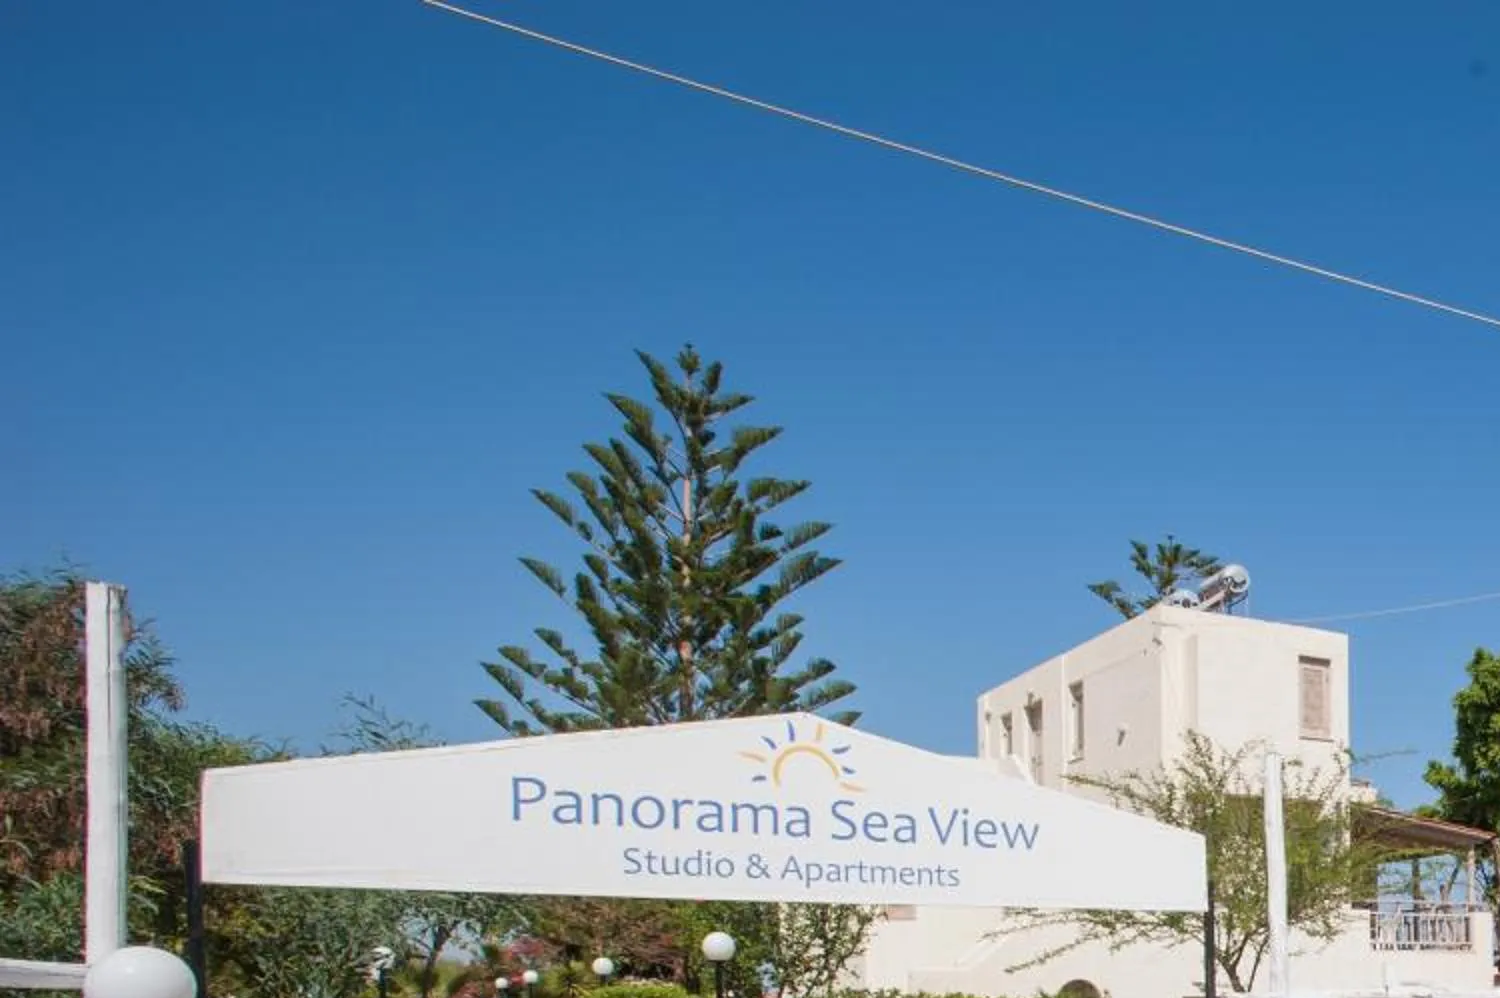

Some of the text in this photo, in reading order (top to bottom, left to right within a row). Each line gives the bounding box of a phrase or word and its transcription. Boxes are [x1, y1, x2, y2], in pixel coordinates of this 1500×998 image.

[511, 776, 1040, 851] Panorama Sea View
[622, 847, 961, 888] Studio & Apartments
